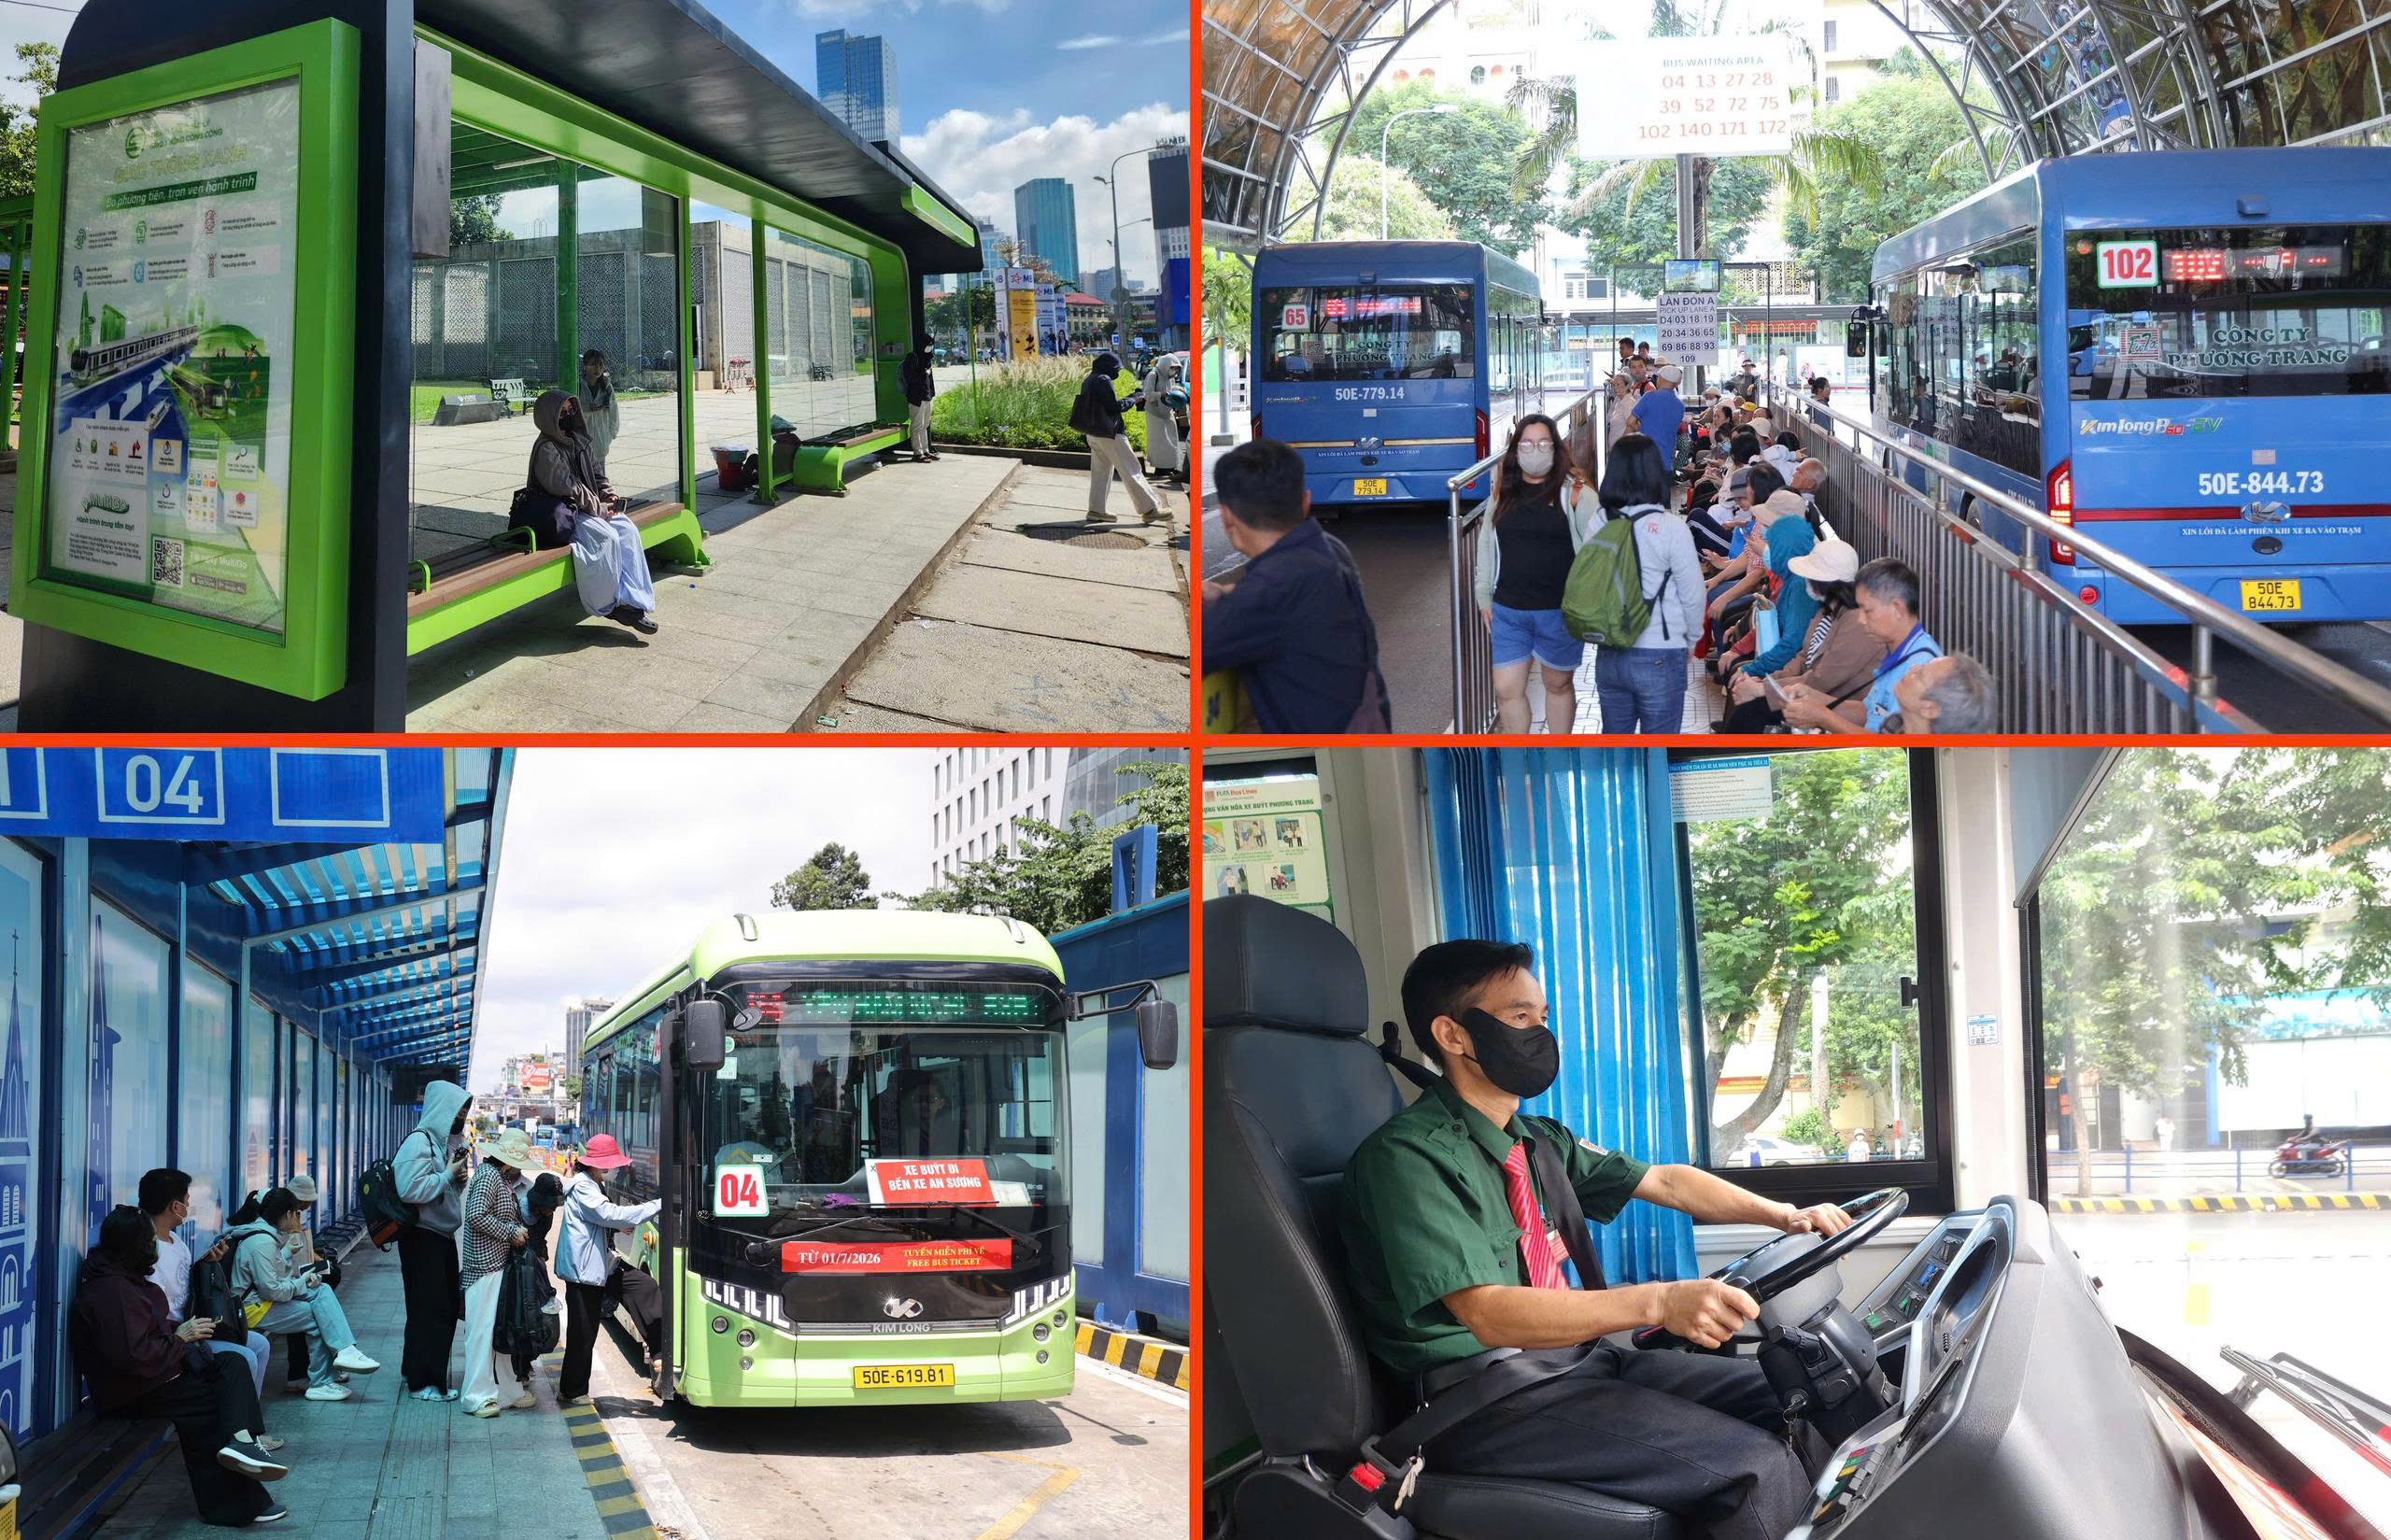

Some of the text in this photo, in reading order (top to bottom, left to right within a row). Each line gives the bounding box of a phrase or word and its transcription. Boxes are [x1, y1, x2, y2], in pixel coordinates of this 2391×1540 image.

[1662, 56, 1764, 67] BUS WAITING AREA
[1662, 72, 1773, 90] 04 13 27 28
[1660, 96, 1779, 114] 39 52 72 75
[1638, 120, 1787, 139] 102 140 171 172
[2101, 247, 2154, 279] 102
[1660, 294, 1715, 306] LÀN ĐÓN A
[1285, 308, 1306, 326] 65
[1660, 316, 1672, 324] D4
[1689, 315, 1700, 323] 18
[1676, 329, 1686, 337] 34
[1704, 328, 1715, 336] 65
[2213, 324, 2311, 344] CÔNG TY
[1395, 340, 1411, 348] TY
[1662, 342, 1715, 351] 69 86 88 93
[1681, 355, 1695, 363] 109
[2267, 349, 2348, 365] TRANG
[1336, 387, 1405, 401] 50E-779.14
[2198, 470, 2324, 496] 50E-844.73
[2182, 528, 2196, 536] XIN
[2228, 525, 2246, 535] LÀM
[2275, 526, 2290, 535] KHI
[2292, 526, 2303, 534] XE
[2305, 526, 2316, 534] RA
[2316, 525, 2336, 534] VÀO
[2337, 526, 2362, 536] TRẠM
[2257, 582, 2284, 596] 50E
[2248, 596, 2295, 610] 844.73
[126, 755, 204, 814] 04
[903, 1162, 959, 1176] XE BUÝT ĐI
[720, 1173, 758, 1208] 04
[888, 1176, 982, 1192] BẾN XE AN SƯƠNG
[798, 1249, 881, 1265] TỪ 01/7/2026
[957, 1246, 972, 1256] PHÍ
[907, 1257, 981, 1267] FREE BUS TICKET
[872, 1322, 930, 1333] KIM LONG
[863, 1368, 944, 1384] 50E-619.81
